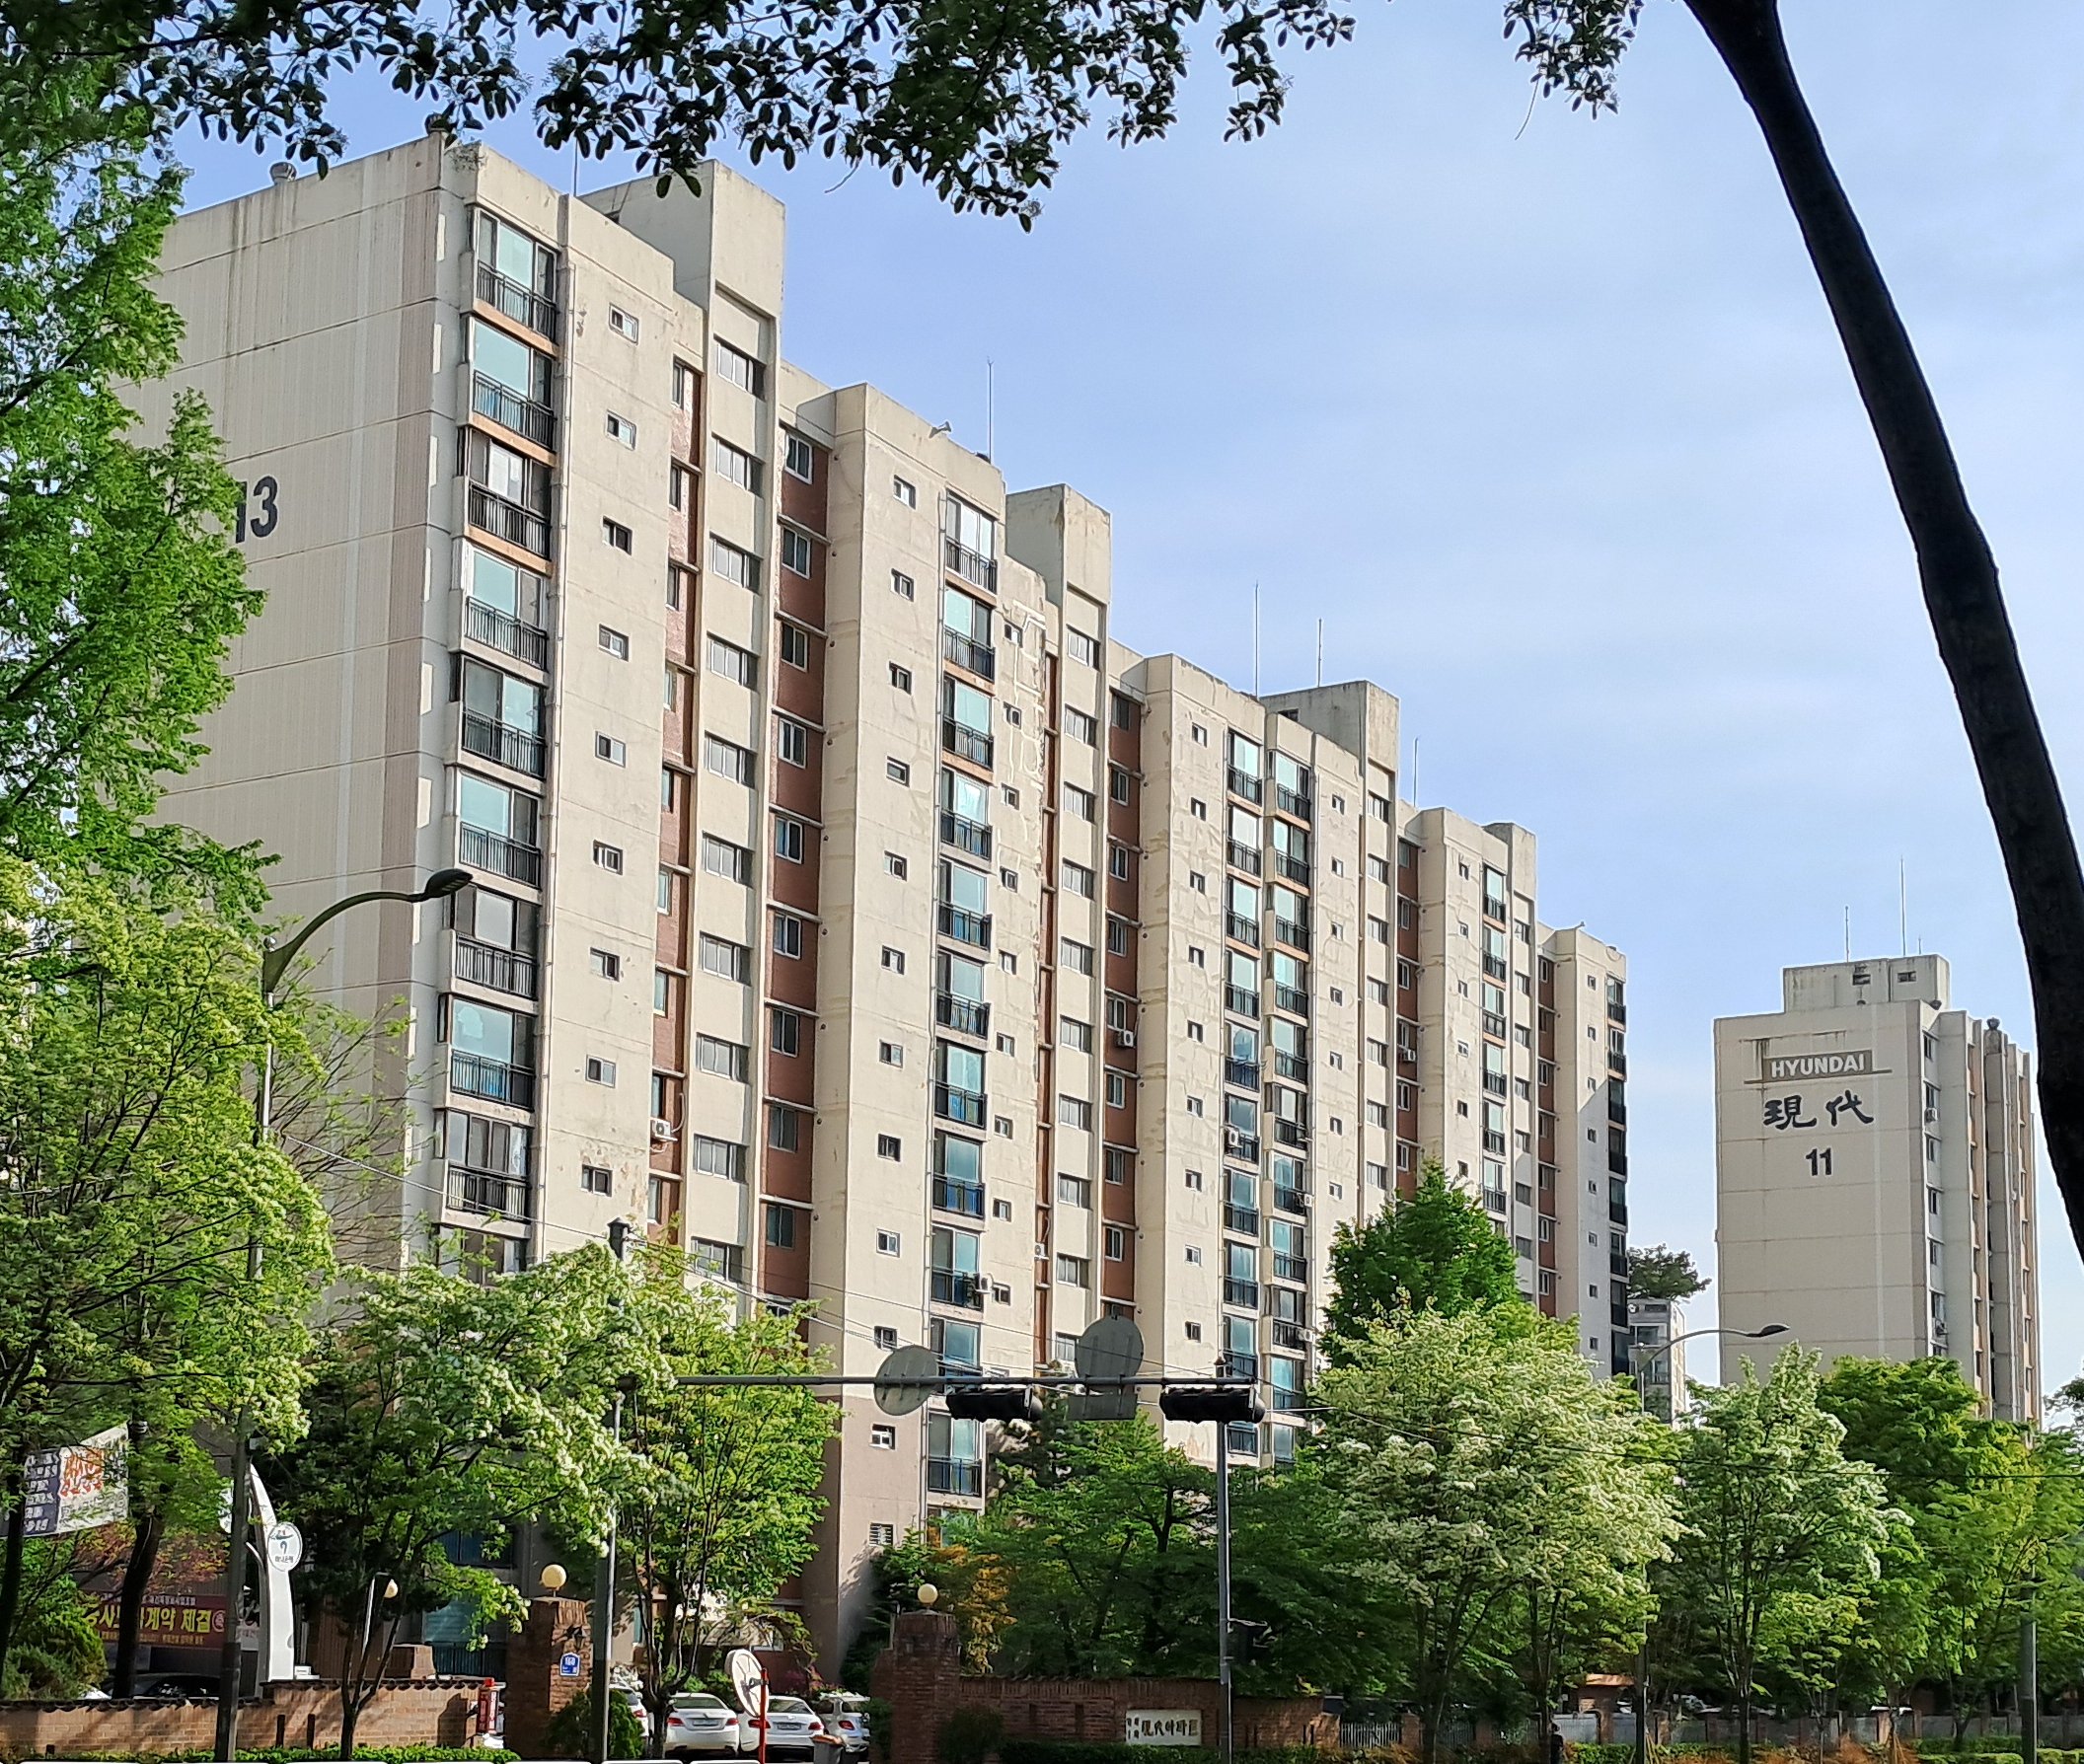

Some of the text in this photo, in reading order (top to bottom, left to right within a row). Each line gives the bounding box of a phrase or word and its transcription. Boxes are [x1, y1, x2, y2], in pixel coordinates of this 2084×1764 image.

[1770, 1053, 1865, 1078] HYUNDAI
[1762, 1089, 1874, 1130] 現代
[1806, 1147, 1832, 1176] 11
[181, 1606, 211, 1634] 체결
